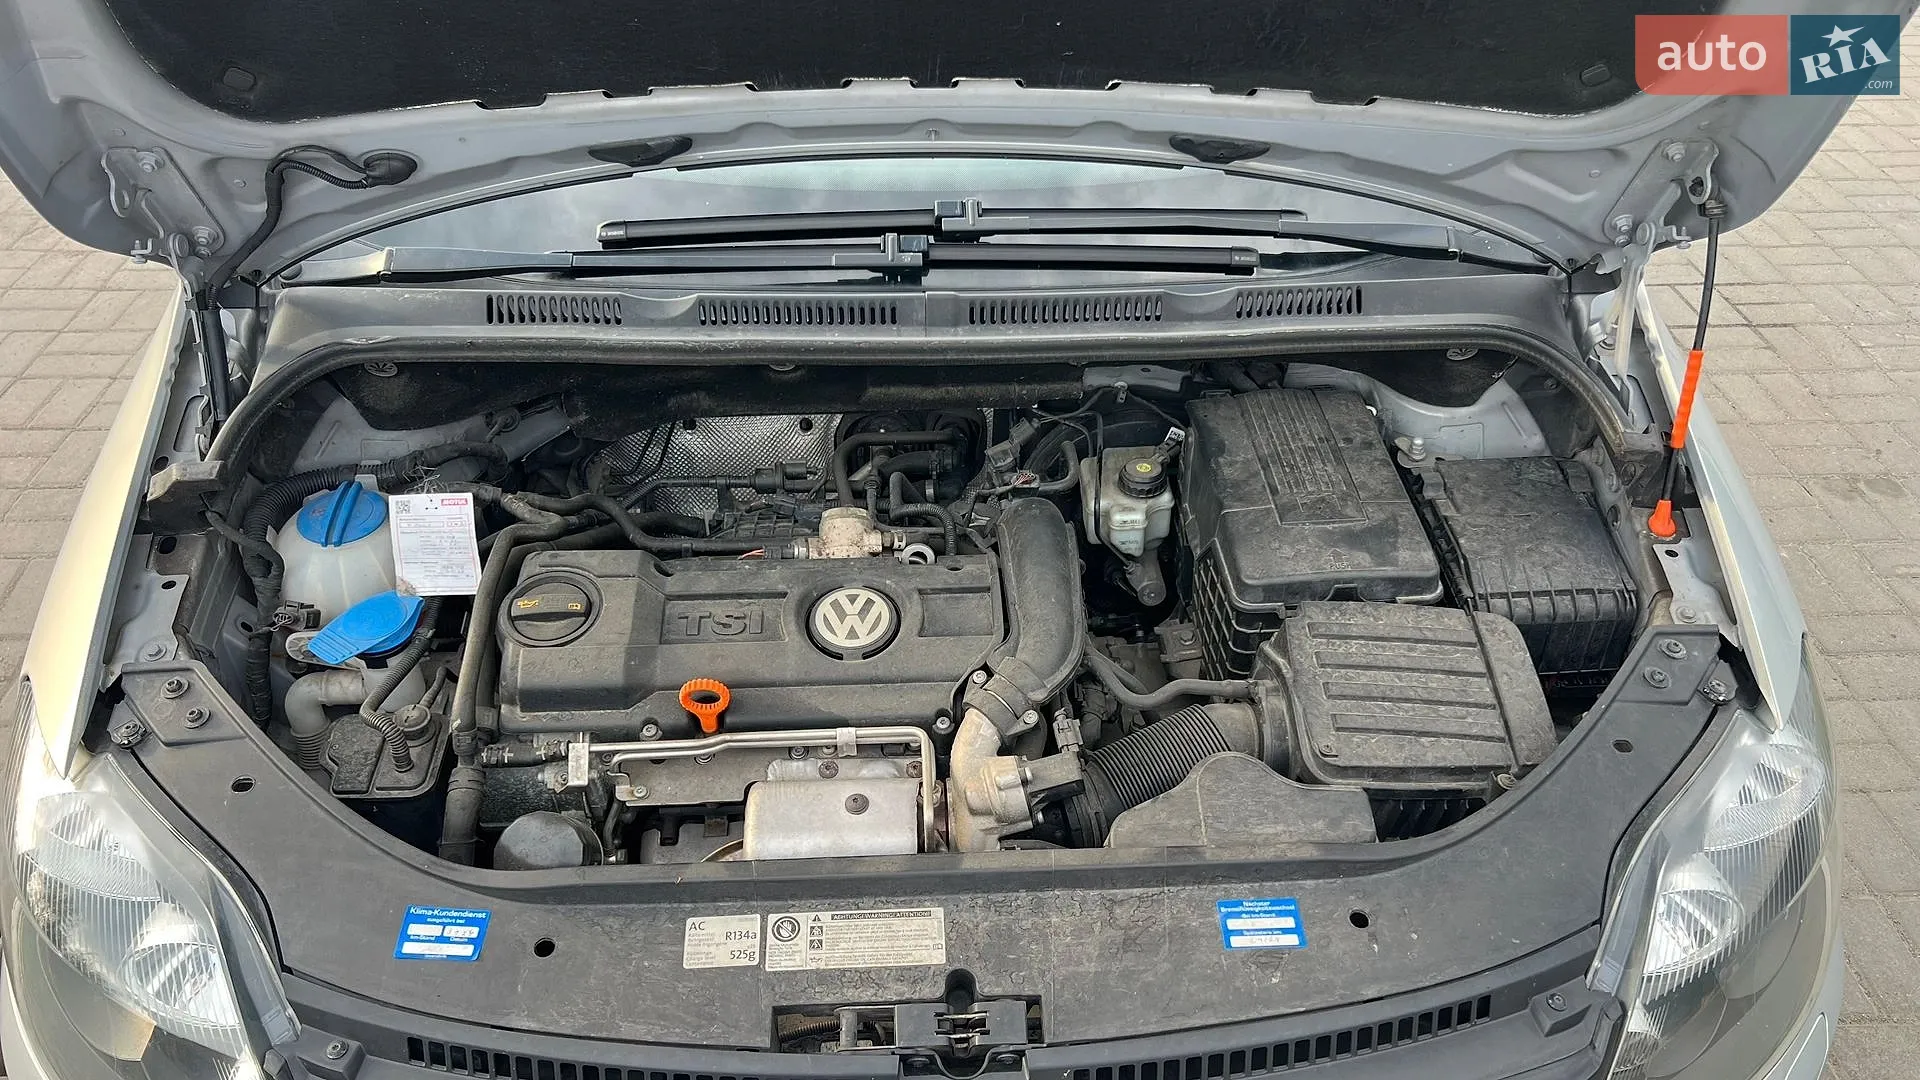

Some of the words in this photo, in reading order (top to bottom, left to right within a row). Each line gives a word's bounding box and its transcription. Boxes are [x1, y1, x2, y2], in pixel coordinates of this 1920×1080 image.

[677, 610, 765, 636] TSI
[410, 906, 487, 919] Klima-Kundendienst
[688, 921, 706, 931] AC
[725, 930, 757, 941] R134a
[729, 949, 756, 961] 525g
